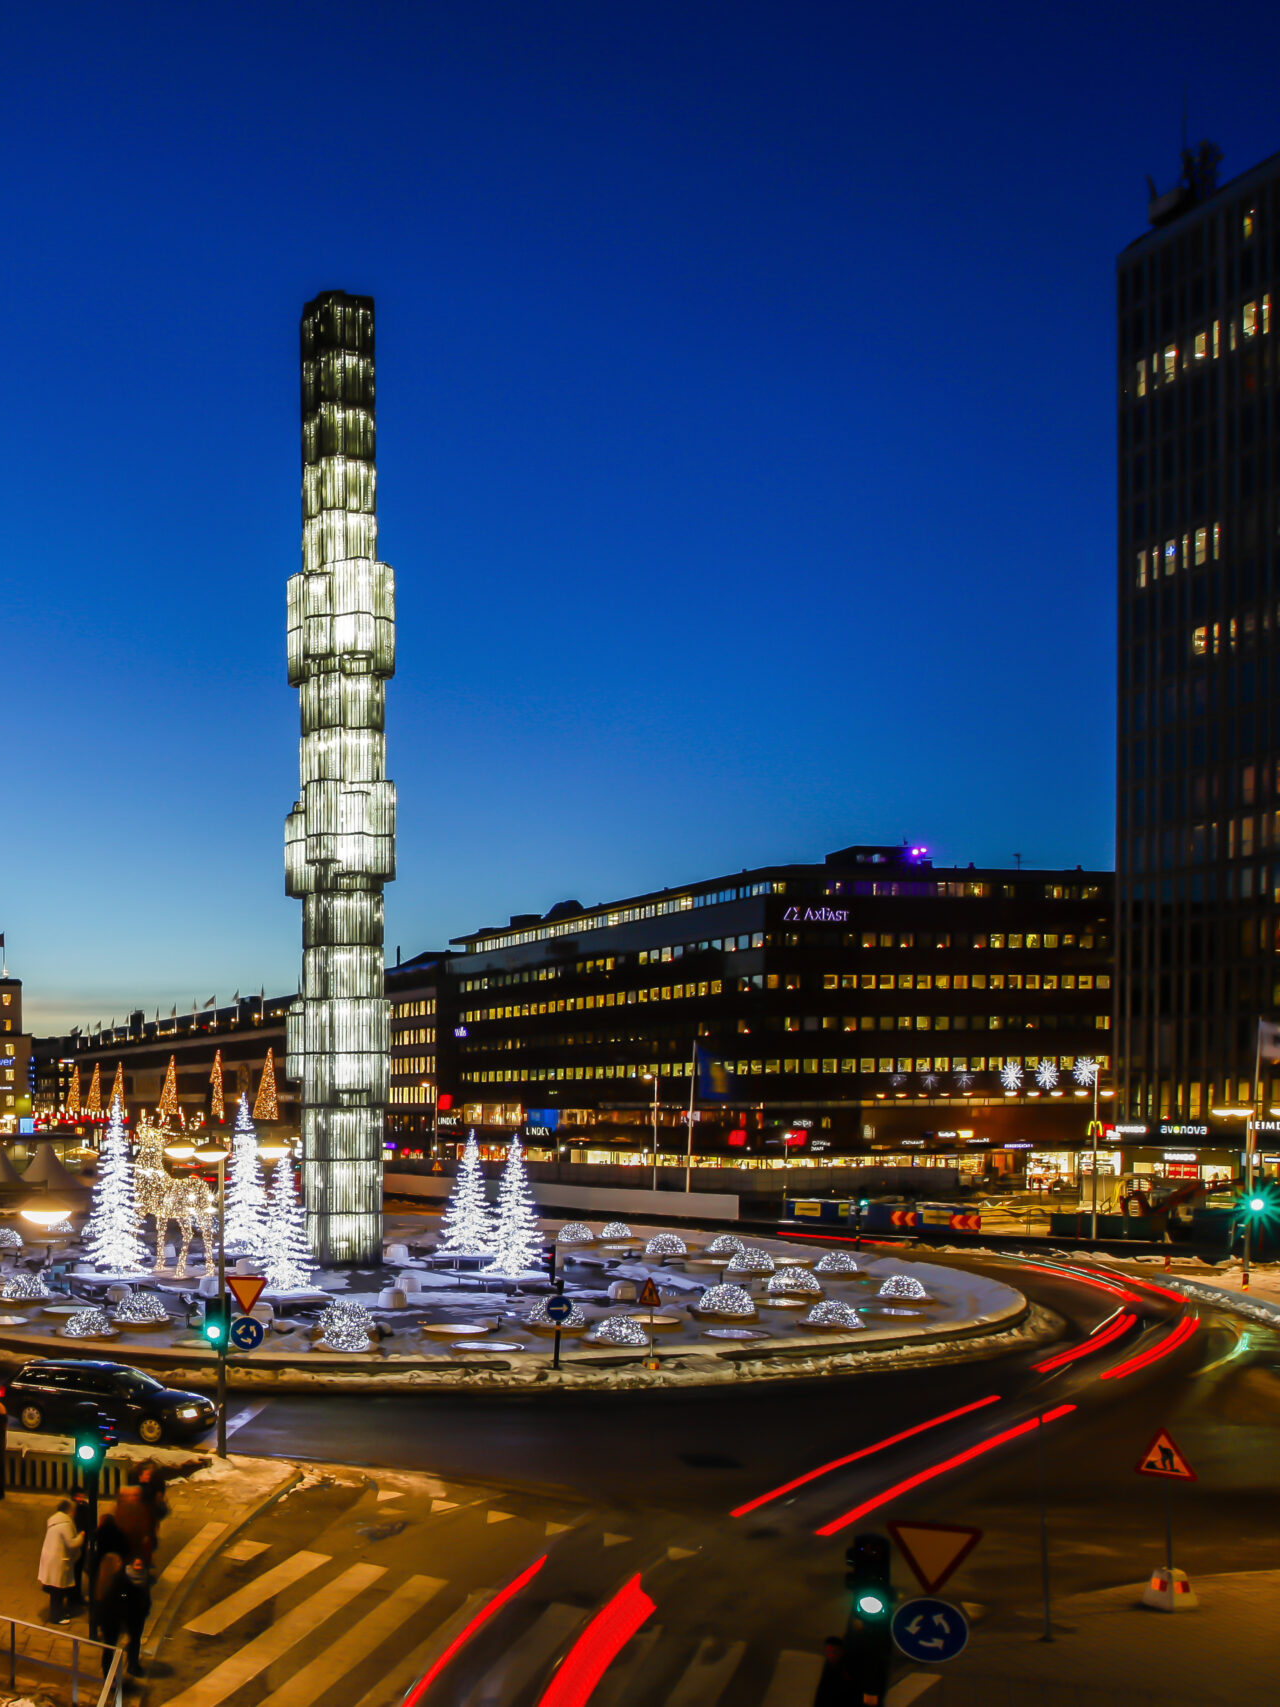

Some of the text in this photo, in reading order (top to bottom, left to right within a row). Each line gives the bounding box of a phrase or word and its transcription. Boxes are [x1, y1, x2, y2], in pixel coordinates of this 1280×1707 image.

[438, 1117, 457, 1125] LINDEX
[526, 1127, 549, 1135] LINDEX
[1160, 1125, 1208, 1135] avonova
